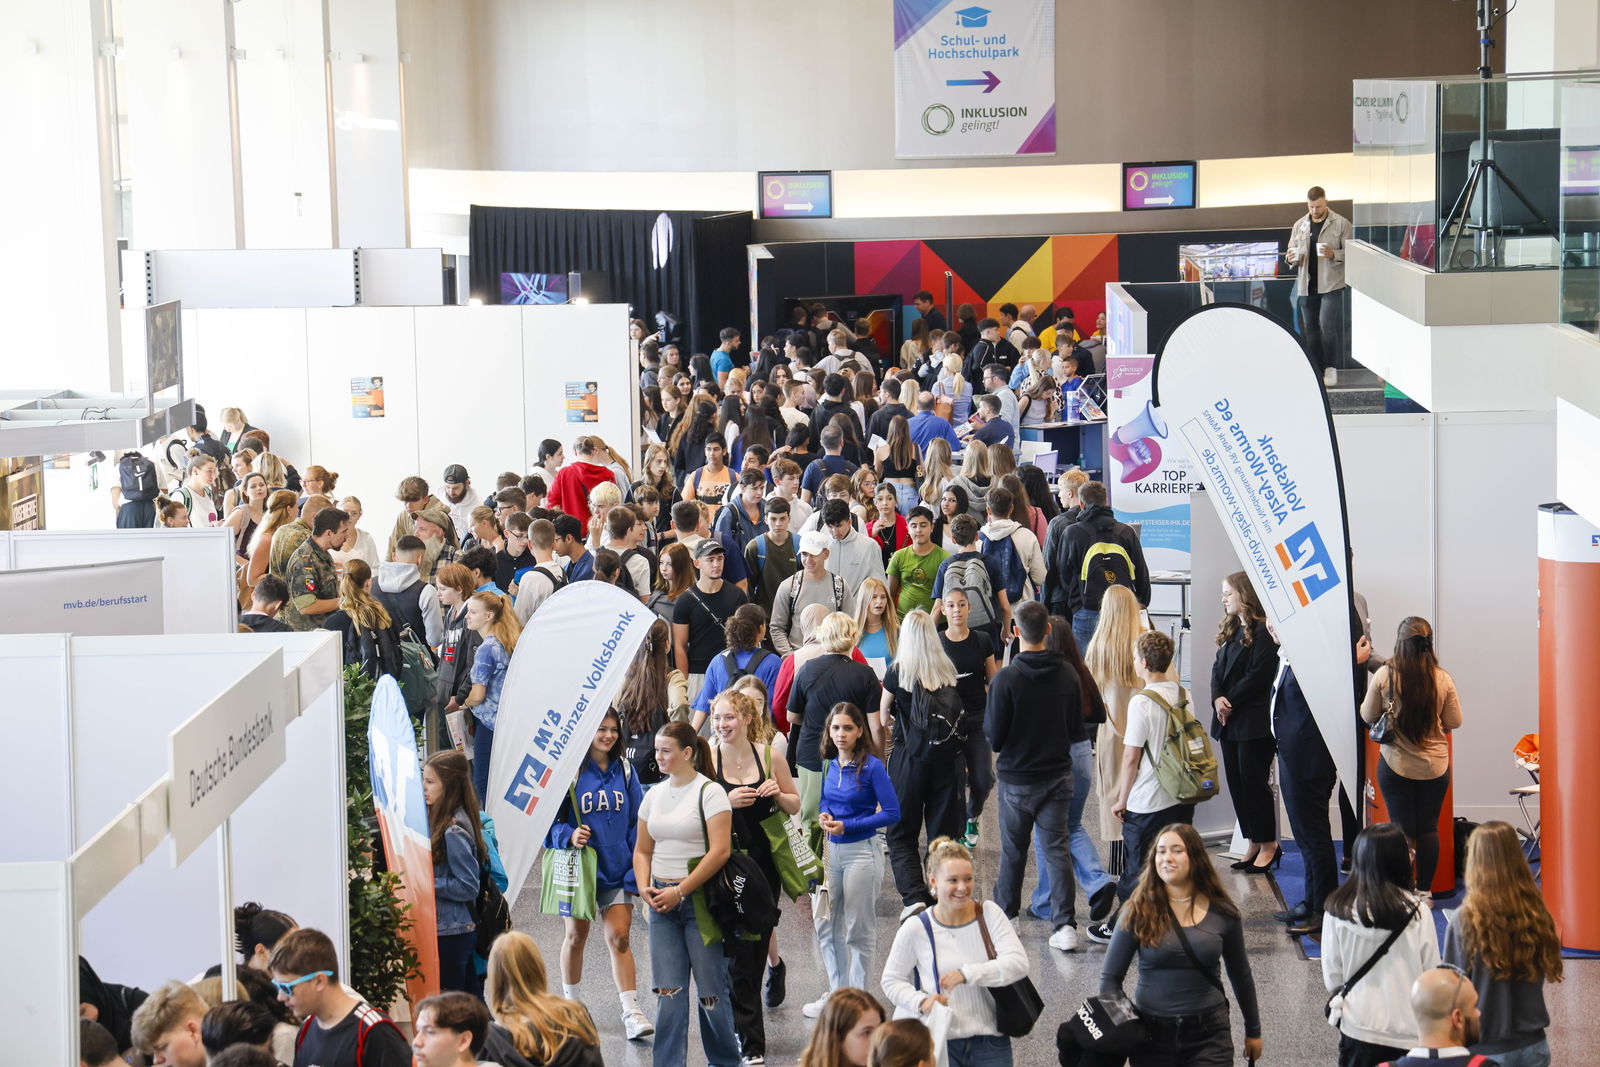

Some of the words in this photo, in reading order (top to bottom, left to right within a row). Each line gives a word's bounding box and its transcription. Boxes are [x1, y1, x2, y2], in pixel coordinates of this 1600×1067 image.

[940, 34, 980, 47] Schul-
[983, 34, 1006, 45] und
[928, 46, 1019, 60] Hochschulpark
[961, 106, 1027, 119] INKLUSION
[960, 119, 1000, 133] gelingt!
[1162, 470, 1187, 481] TOP
[63, 594, 148, 610] mvb.de/berufsstart
[548, 693, 590, 761] Mainzer
[582, 610, 636, 691] Volksbank
[189, 747, 227, 808] Deutsche
[228, 702, 274, 772] Bundesbank
[580, 789, 624, 815] GAP
